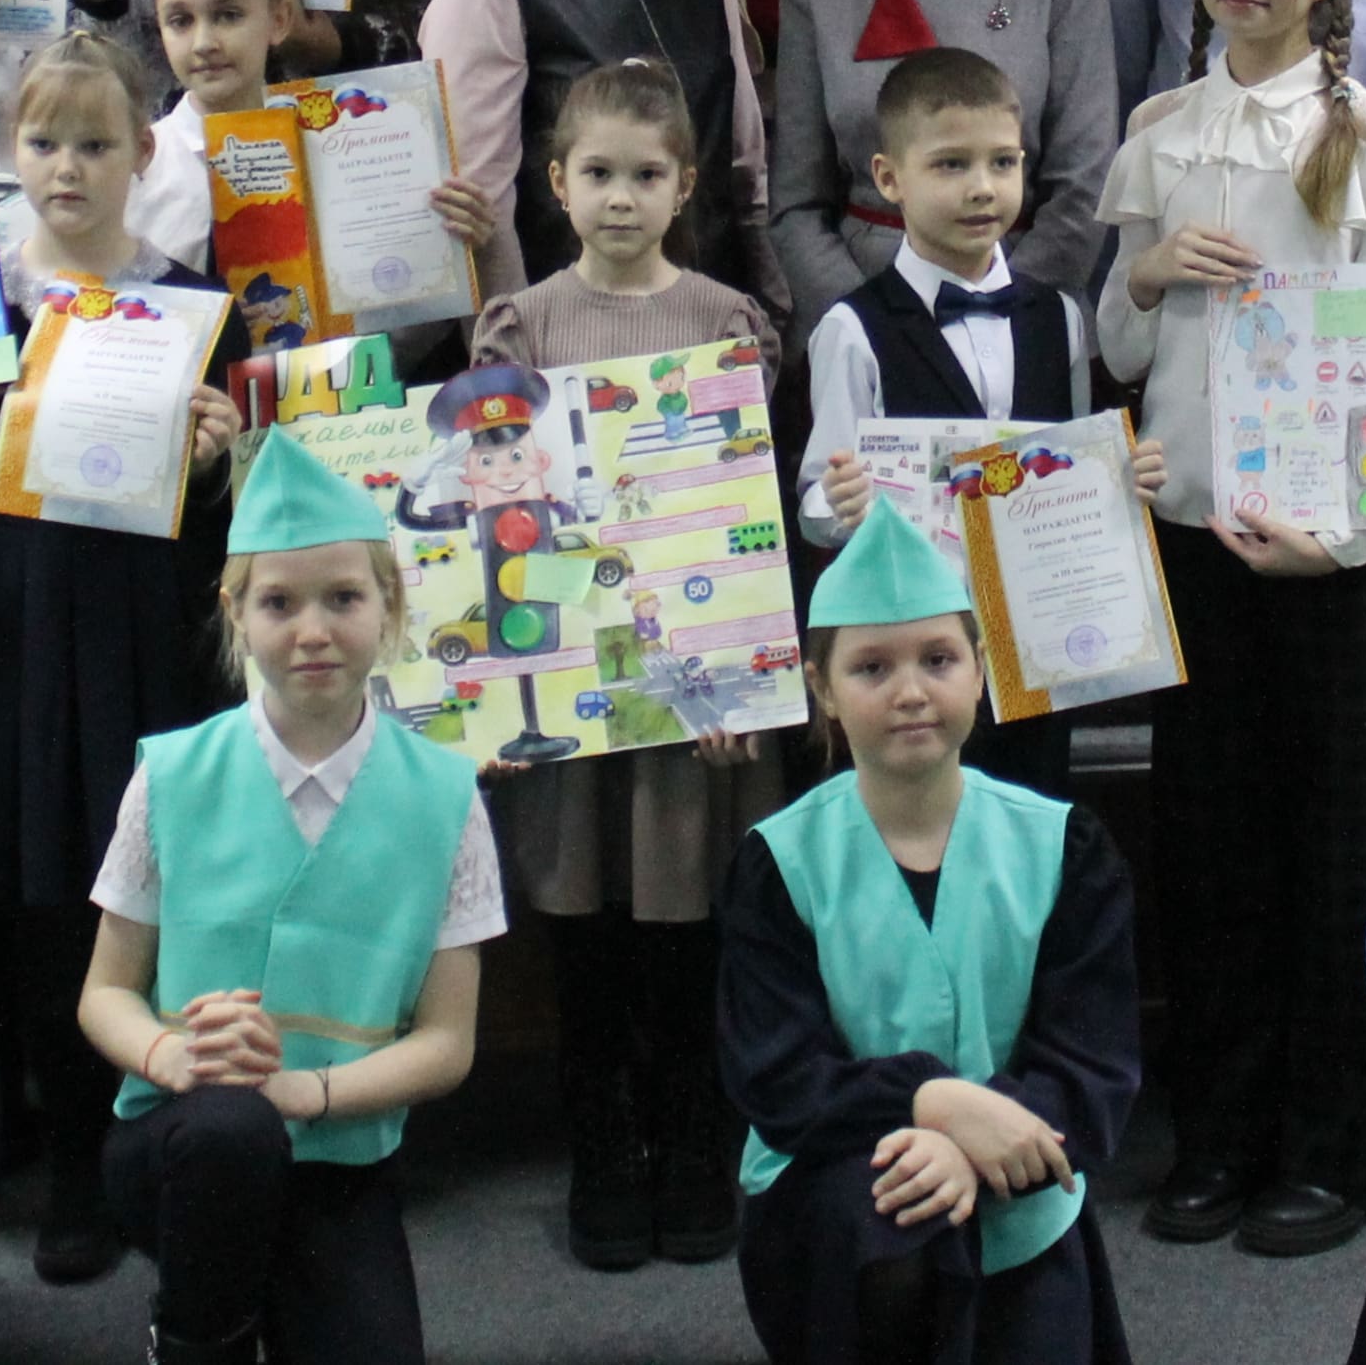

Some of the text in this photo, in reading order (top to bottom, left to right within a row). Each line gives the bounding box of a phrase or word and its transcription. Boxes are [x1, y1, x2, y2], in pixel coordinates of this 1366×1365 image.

[322, 123, 411, 155] Грамота
[226, 333, 407, 435] ПДД
[1007, 484, 1099, 521] Грамота
[688, 580, 709, 599] 50
